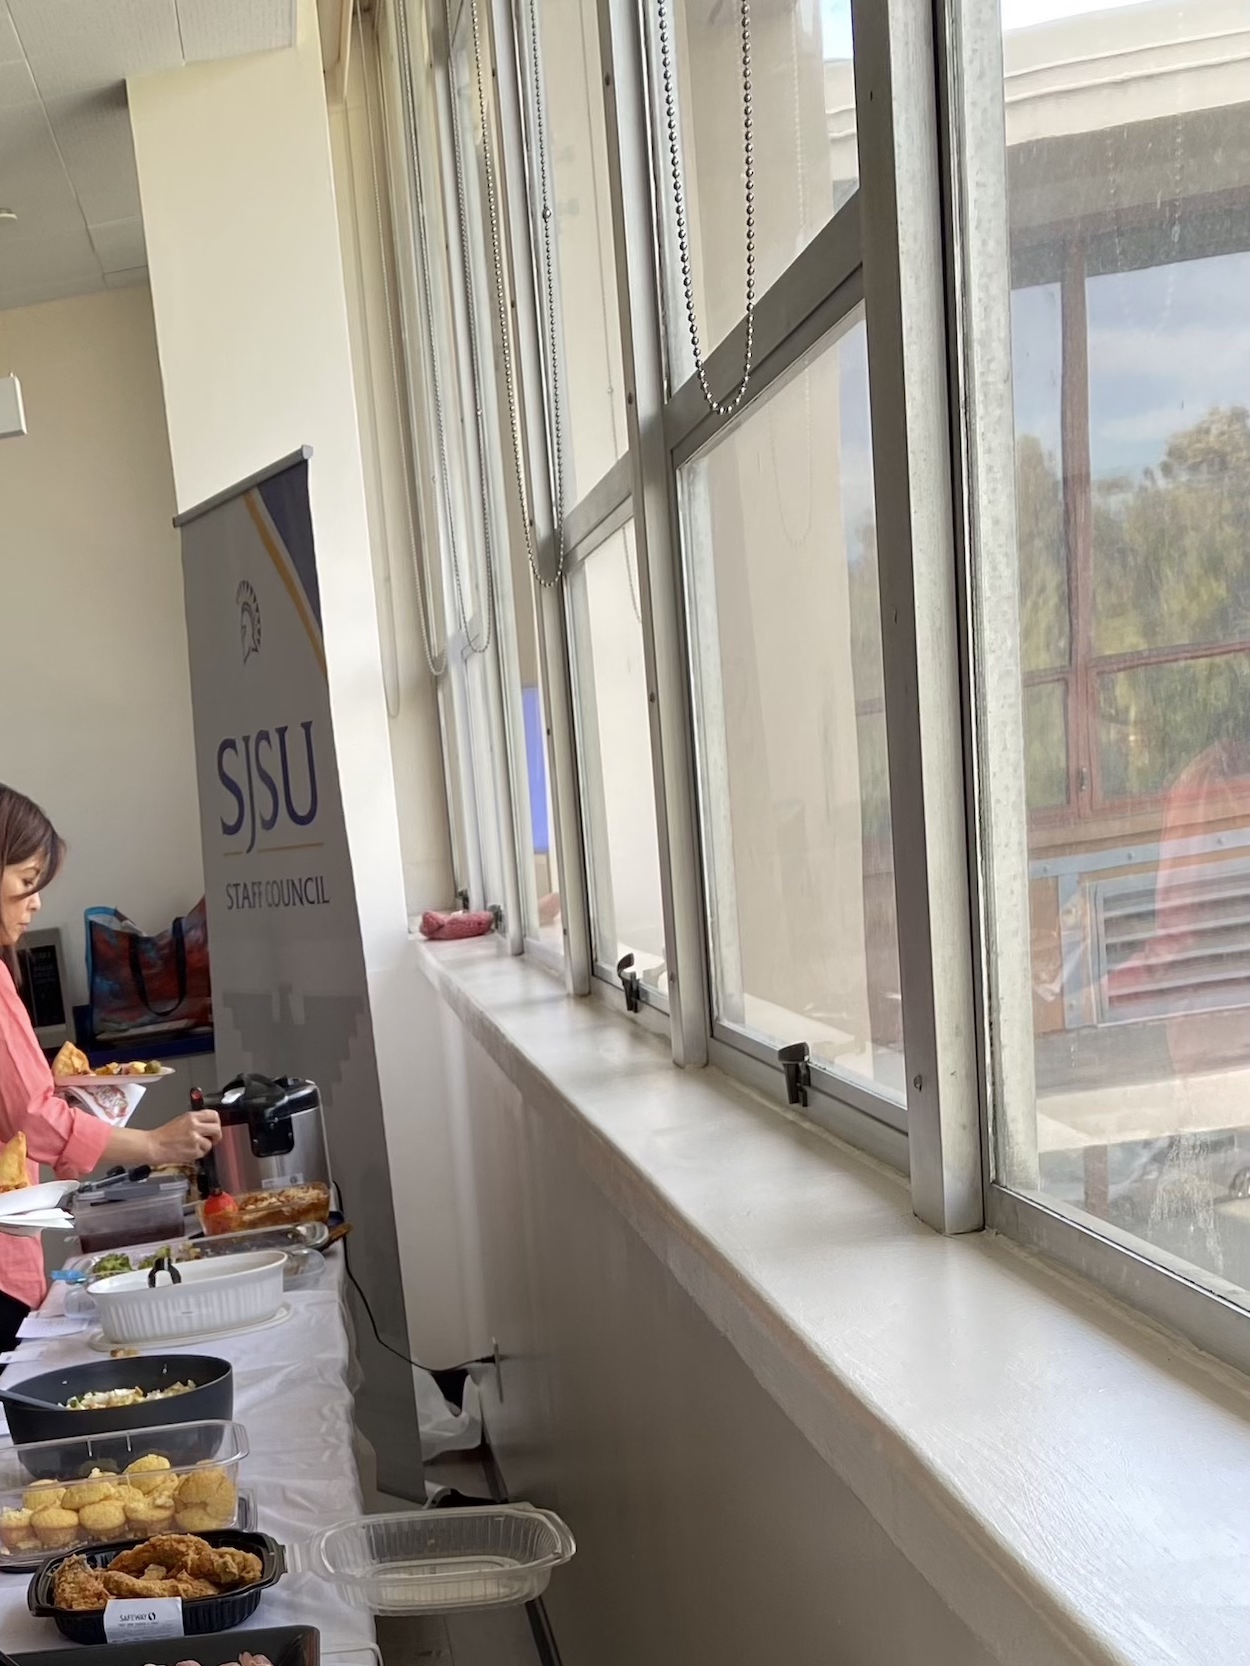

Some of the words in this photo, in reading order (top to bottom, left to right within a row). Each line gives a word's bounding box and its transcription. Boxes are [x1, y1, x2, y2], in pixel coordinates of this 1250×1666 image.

[217, 720, 319, 853] SJSU
[226, 880, 262, 911] STAFF
[265, 876, 330, 908] COUNCIL
